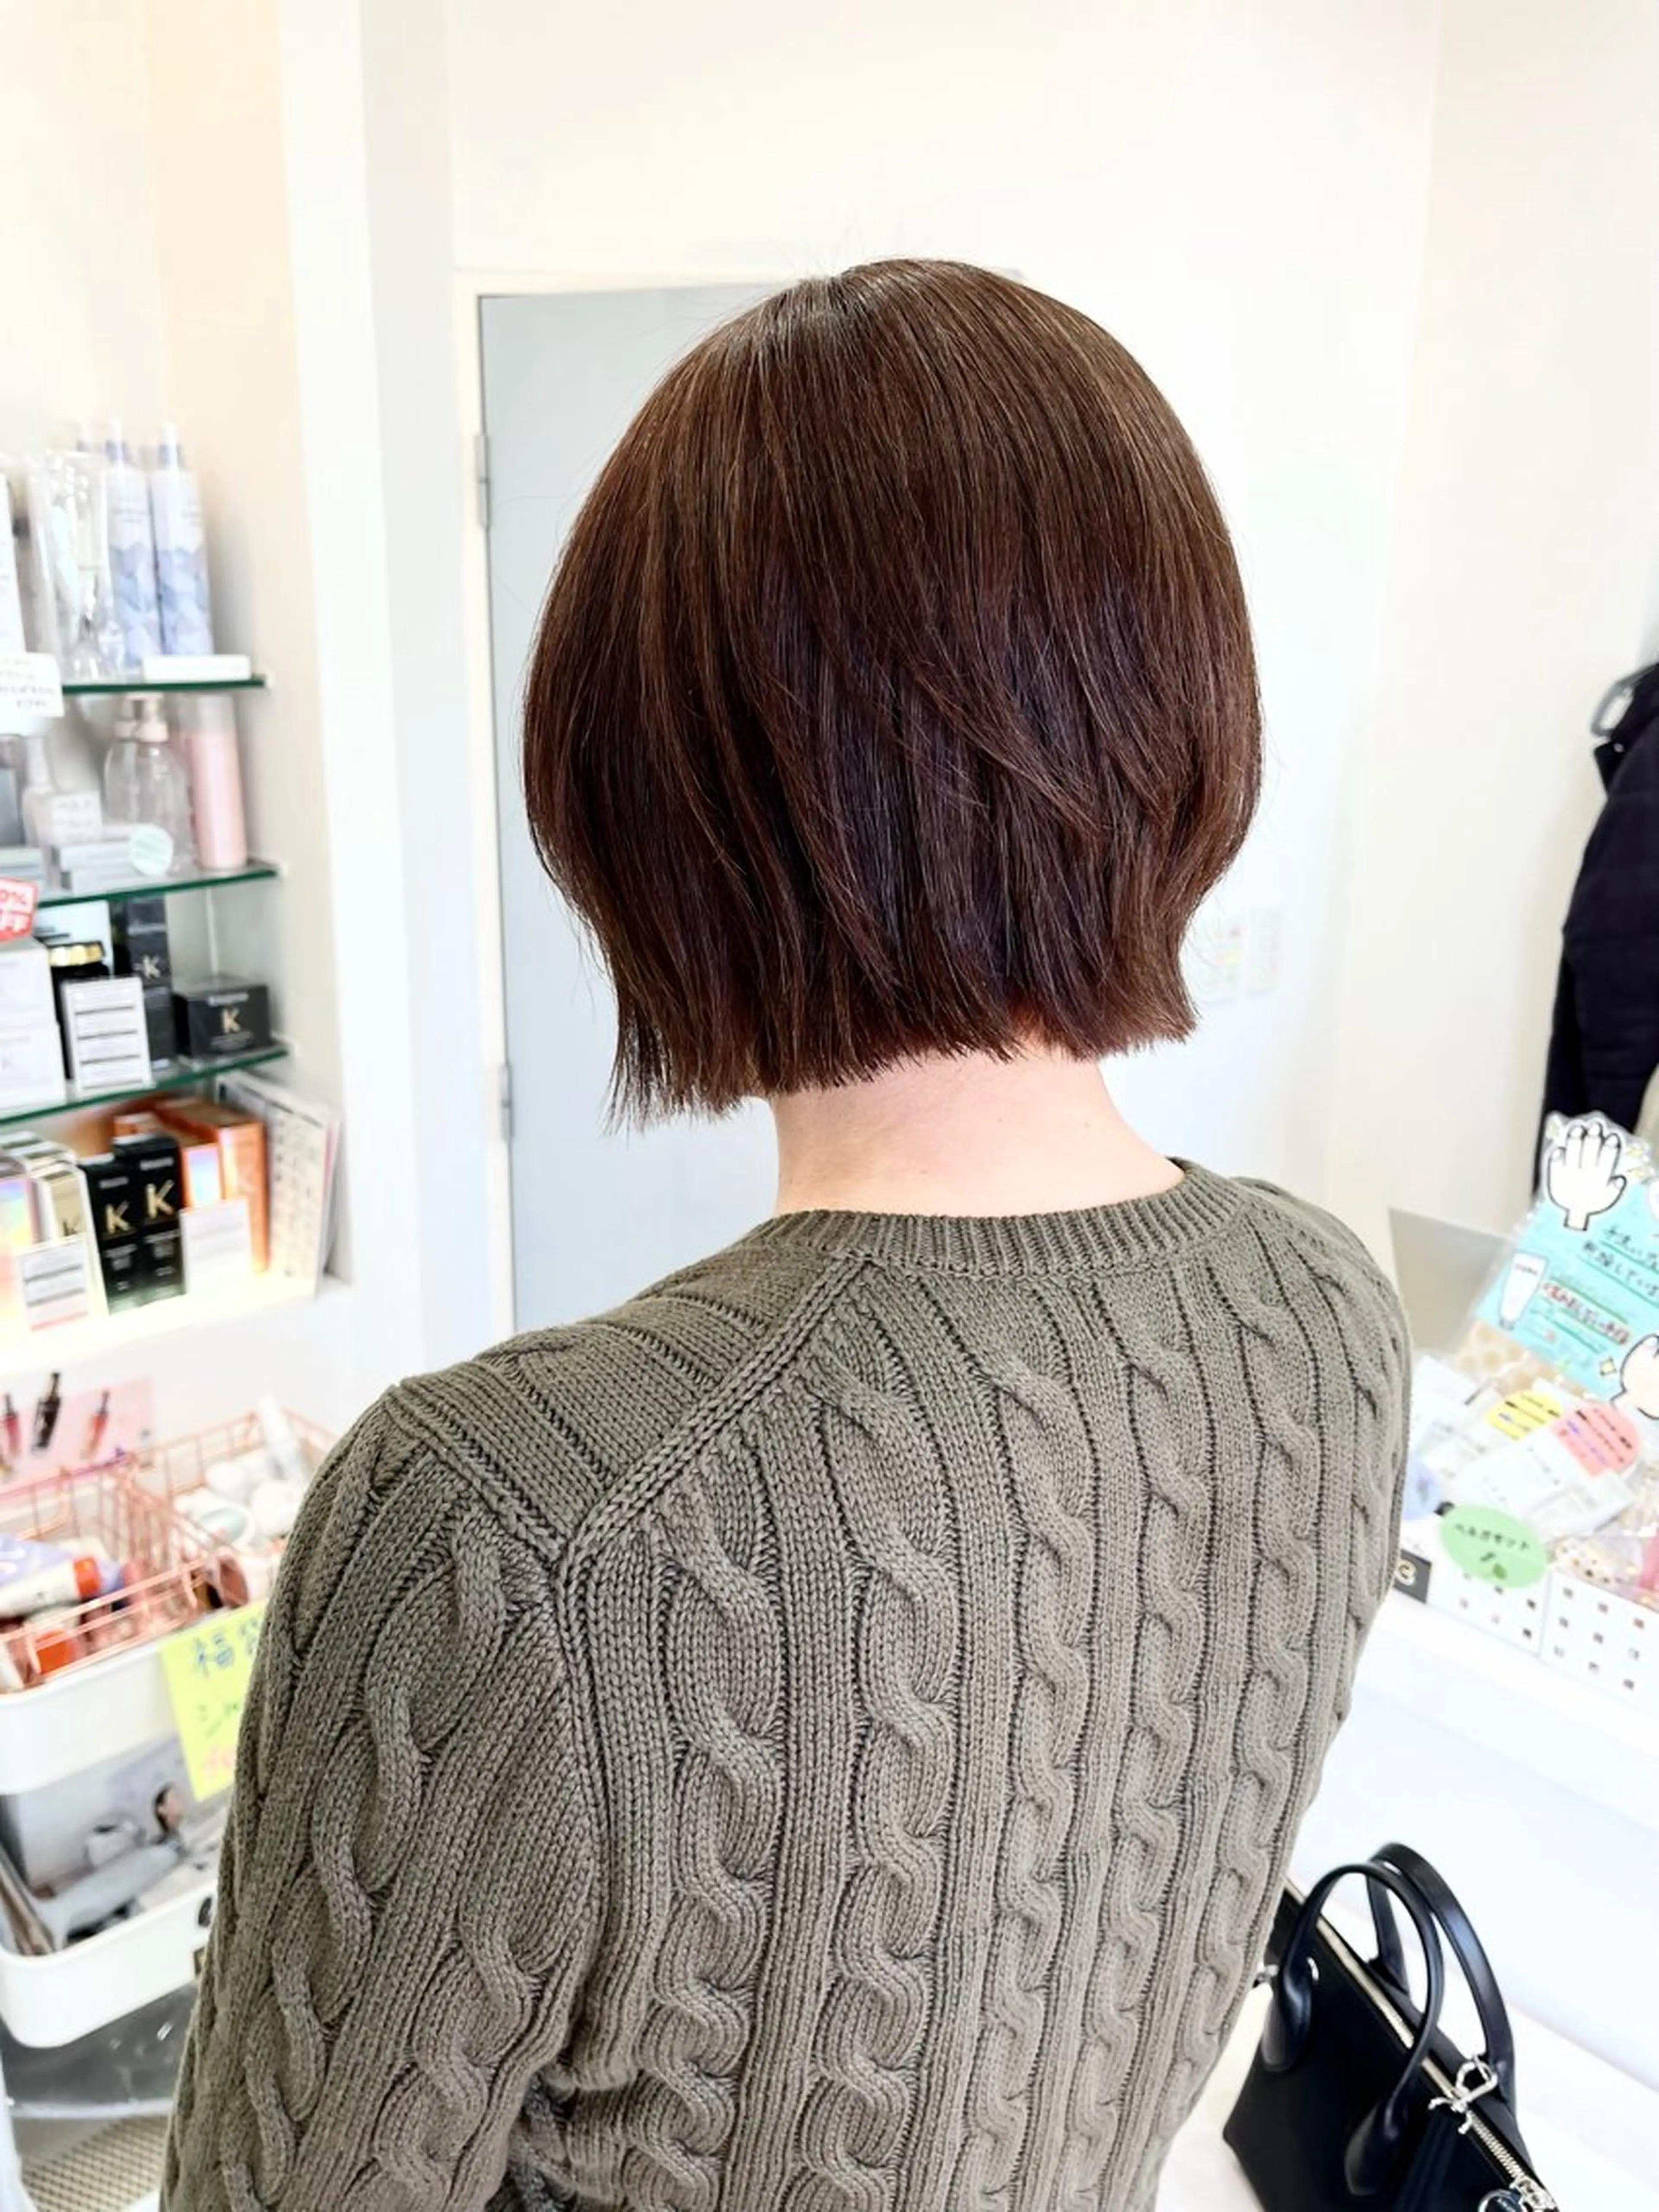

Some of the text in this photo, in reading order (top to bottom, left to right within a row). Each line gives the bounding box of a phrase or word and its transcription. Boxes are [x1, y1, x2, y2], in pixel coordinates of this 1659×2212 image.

[142, 955, 161, 978] K
[222, 1007, 240, 1033] K
[146, 1179, 174, 1219] K
[105, 1200, 130, 1234] K
